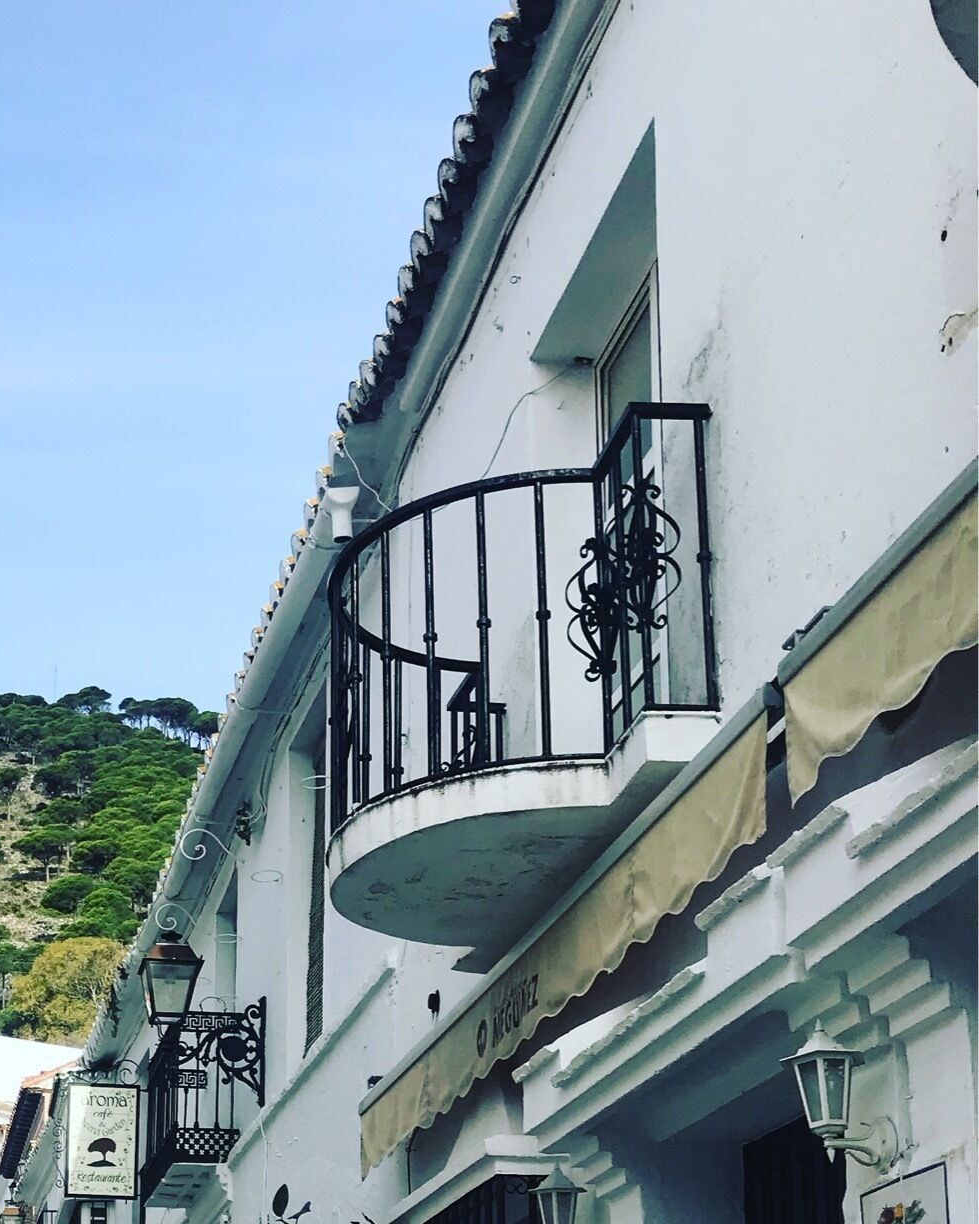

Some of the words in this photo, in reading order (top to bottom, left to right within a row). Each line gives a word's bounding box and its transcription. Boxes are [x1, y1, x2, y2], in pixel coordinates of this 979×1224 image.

[82, 1094, 128, 1107] aroma
[93, 1108, 112, 1120] café
[102, 1119, 127, 1137] Garden
[76, 1171, 127, 1183] Restaurante
